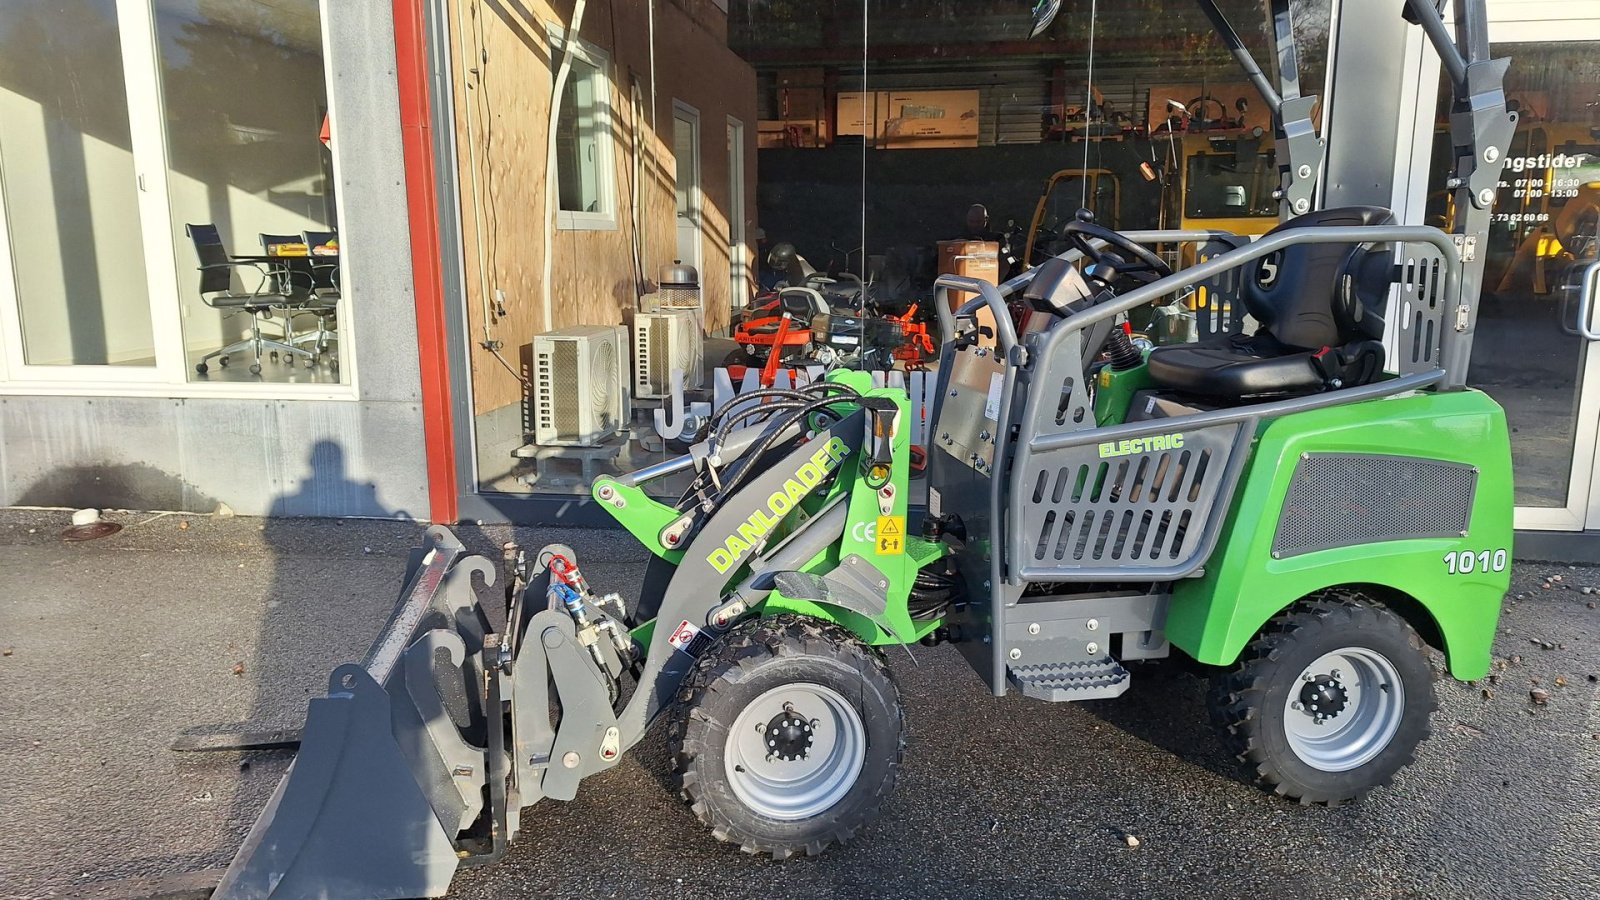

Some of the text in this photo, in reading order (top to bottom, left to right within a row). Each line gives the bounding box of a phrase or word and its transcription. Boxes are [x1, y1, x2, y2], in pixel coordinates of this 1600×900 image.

[1502, 153, 1585, 172] ngstider
[1497, 180, 1510, 188] rs.
[1515, 178, 1543, 188] 07:00
[1552, 178, 1580, 188] 16:30
[1513, 189, 1543, 198] 07:00
[1551, 189, 1579, 198] 13:00
[1497, 213, 1509, 222] 73
[1510, 213, 1522, 222] 62
[1523, 213, 1536, 222] 60
[1536, 213, 1549, 222] 66
[1098, 433, 1184, 458] ELECTRIC
[706, 436, 851, 575] DANLOADER
[1443, 548, 1507, 575] 1010
